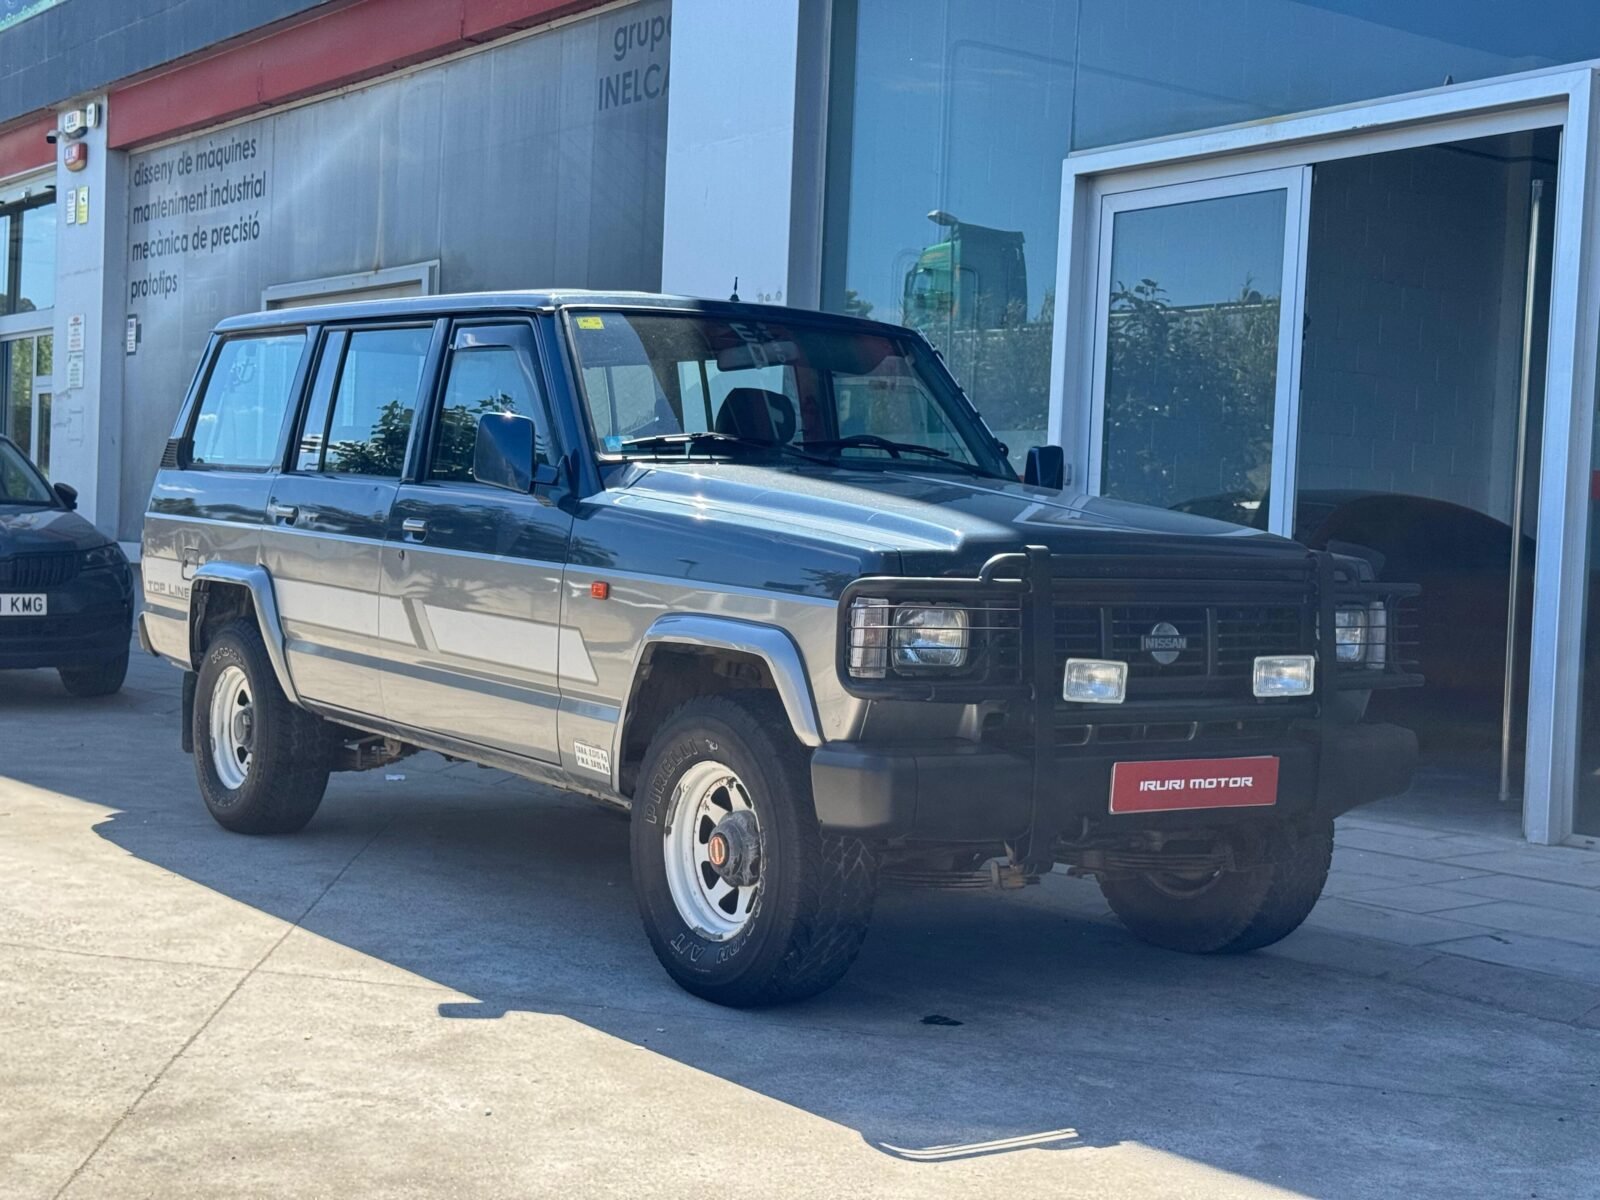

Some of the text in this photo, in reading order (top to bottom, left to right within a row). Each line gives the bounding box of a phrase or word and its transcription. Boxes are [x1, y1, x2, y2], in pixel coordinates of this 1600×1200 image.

[134, 137, 257, 186] disseny de màquines
[133, 171, 266, 225] manteniment industrial
[132, 211, 260, 262] mecànica de precisió
[131, 271, 178, 304] prototips
[10, 596, 43, 612] KMG
[147, 580, 190, 598] TOP LINE
[1145, 637, 1187, 649] NISSAN
[645, 738, 698, 824] PIRELLI
[1139, 776, 1253, 792] IRURI MOTOR
